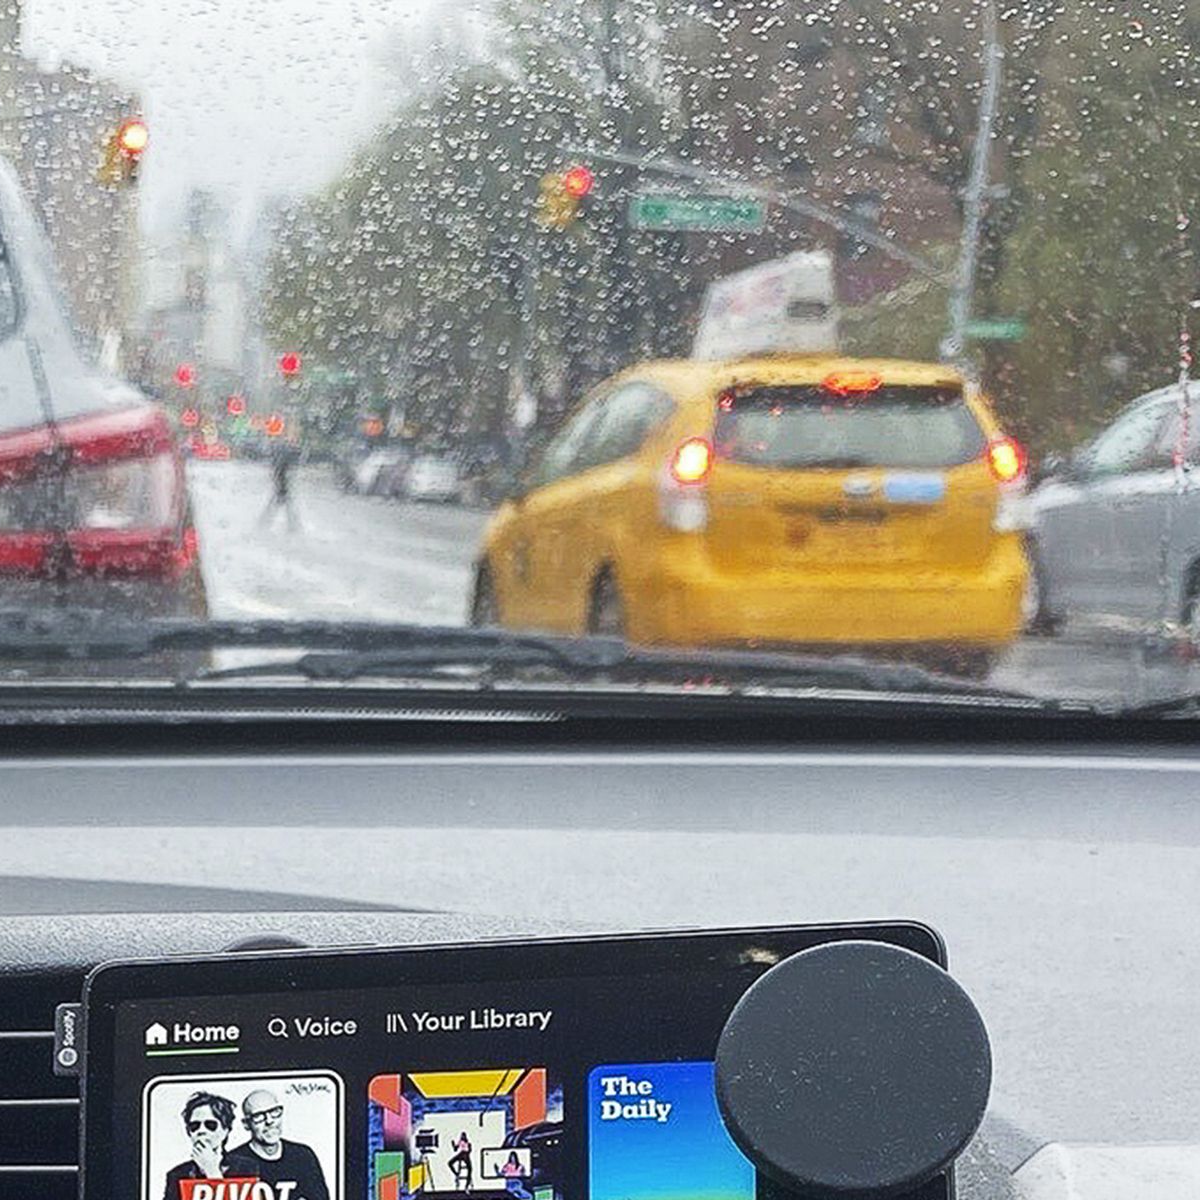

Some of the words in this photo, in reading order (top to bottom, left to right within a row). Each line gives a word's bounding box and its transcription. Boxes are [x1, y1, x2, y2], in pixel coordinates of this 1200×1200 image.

[294, 1017, 357, 1036] Voice
[412, 1012, 465, 1031] Your
[470, 1009, 552, 1031] Library
[174, 1023, 240, 1043] Home
[601, 1076, 652, 1096] The
[601, 1099, 672, 1122] Daily
